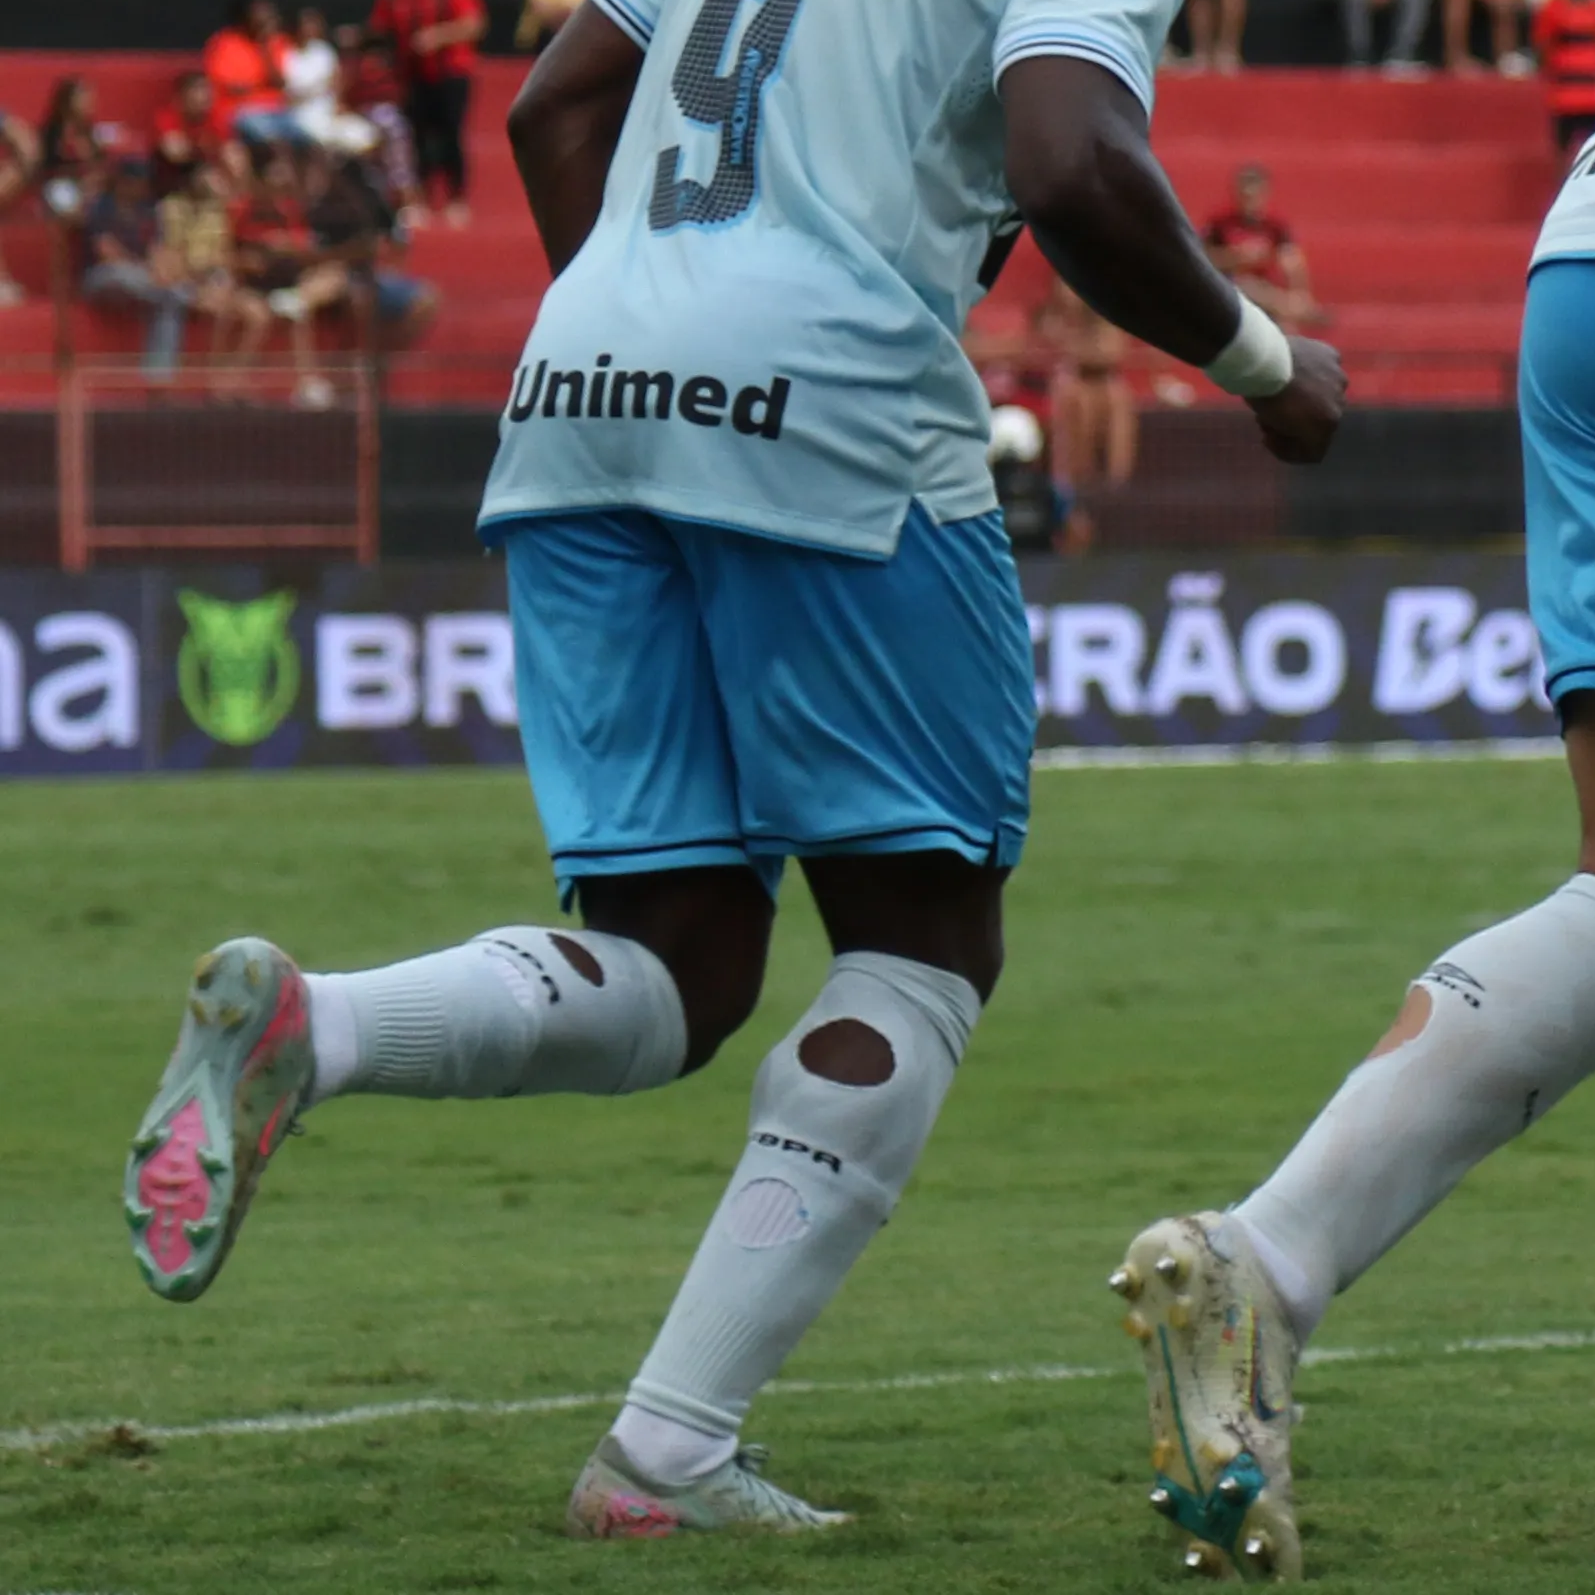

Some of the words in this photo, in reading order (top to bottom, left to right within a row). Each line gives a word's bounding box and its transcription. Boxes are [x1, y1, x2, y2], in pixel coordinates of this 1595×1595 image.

[508, 353, 792, 441] Unimed
[1024, 570, 1347, 716] RÃO
[1371, 585, 1554, 714] Be
[753, 1132, 842, 1174] BPA
